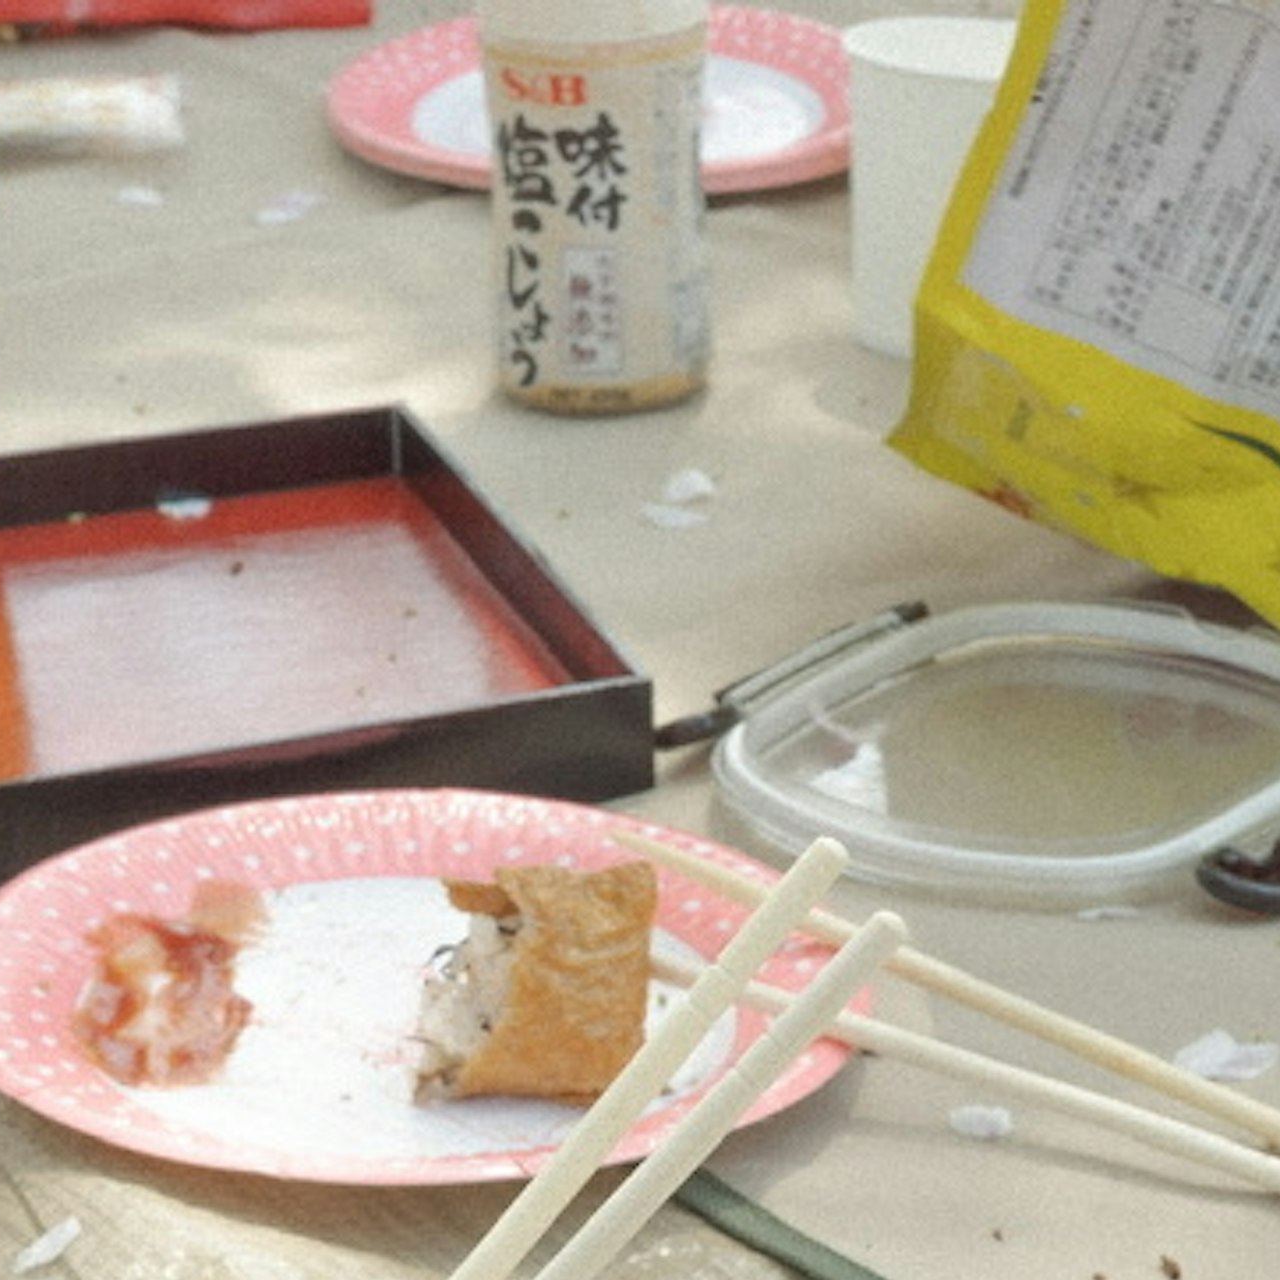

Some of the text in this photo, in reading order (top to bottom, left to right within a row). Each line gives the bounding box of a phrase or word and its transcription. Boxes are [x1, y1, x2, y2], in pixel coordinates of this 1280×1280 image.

[502, 69, 586, 107] S&B
[553, 112, 628, 230] 味付
[496, 112, 558, 387] 塩こしょう
